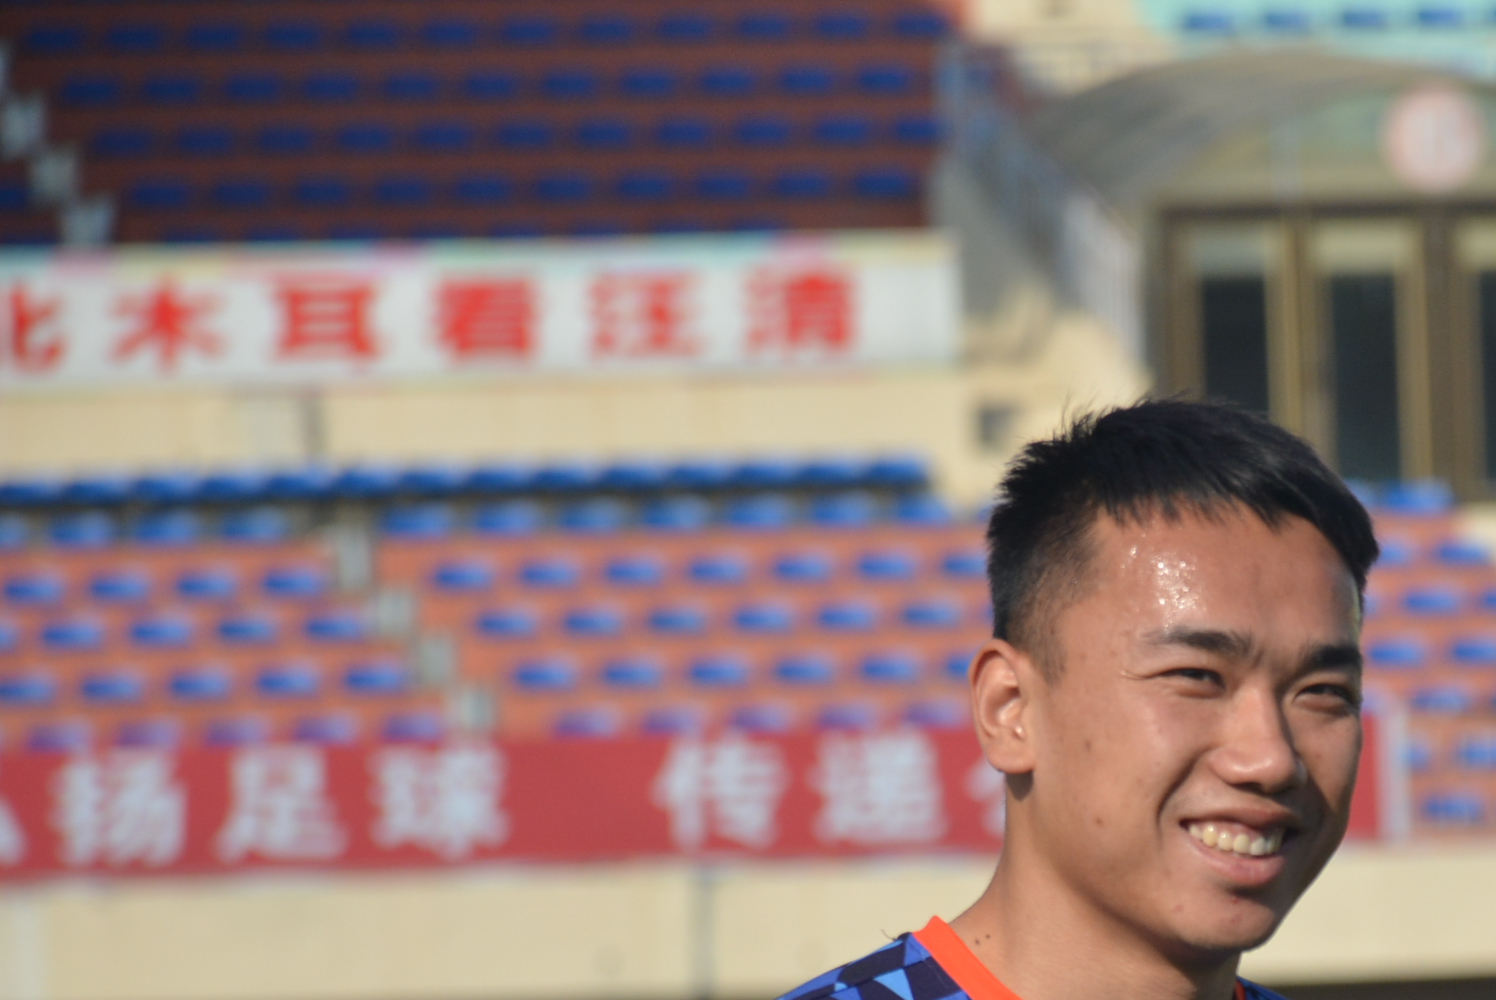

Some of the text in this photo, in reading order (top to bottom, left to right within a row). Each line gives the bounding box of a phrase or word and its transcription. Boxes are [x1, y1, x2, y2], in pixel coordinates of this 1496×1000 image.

[0, 732, 1004, 868] 扬足球 传递
